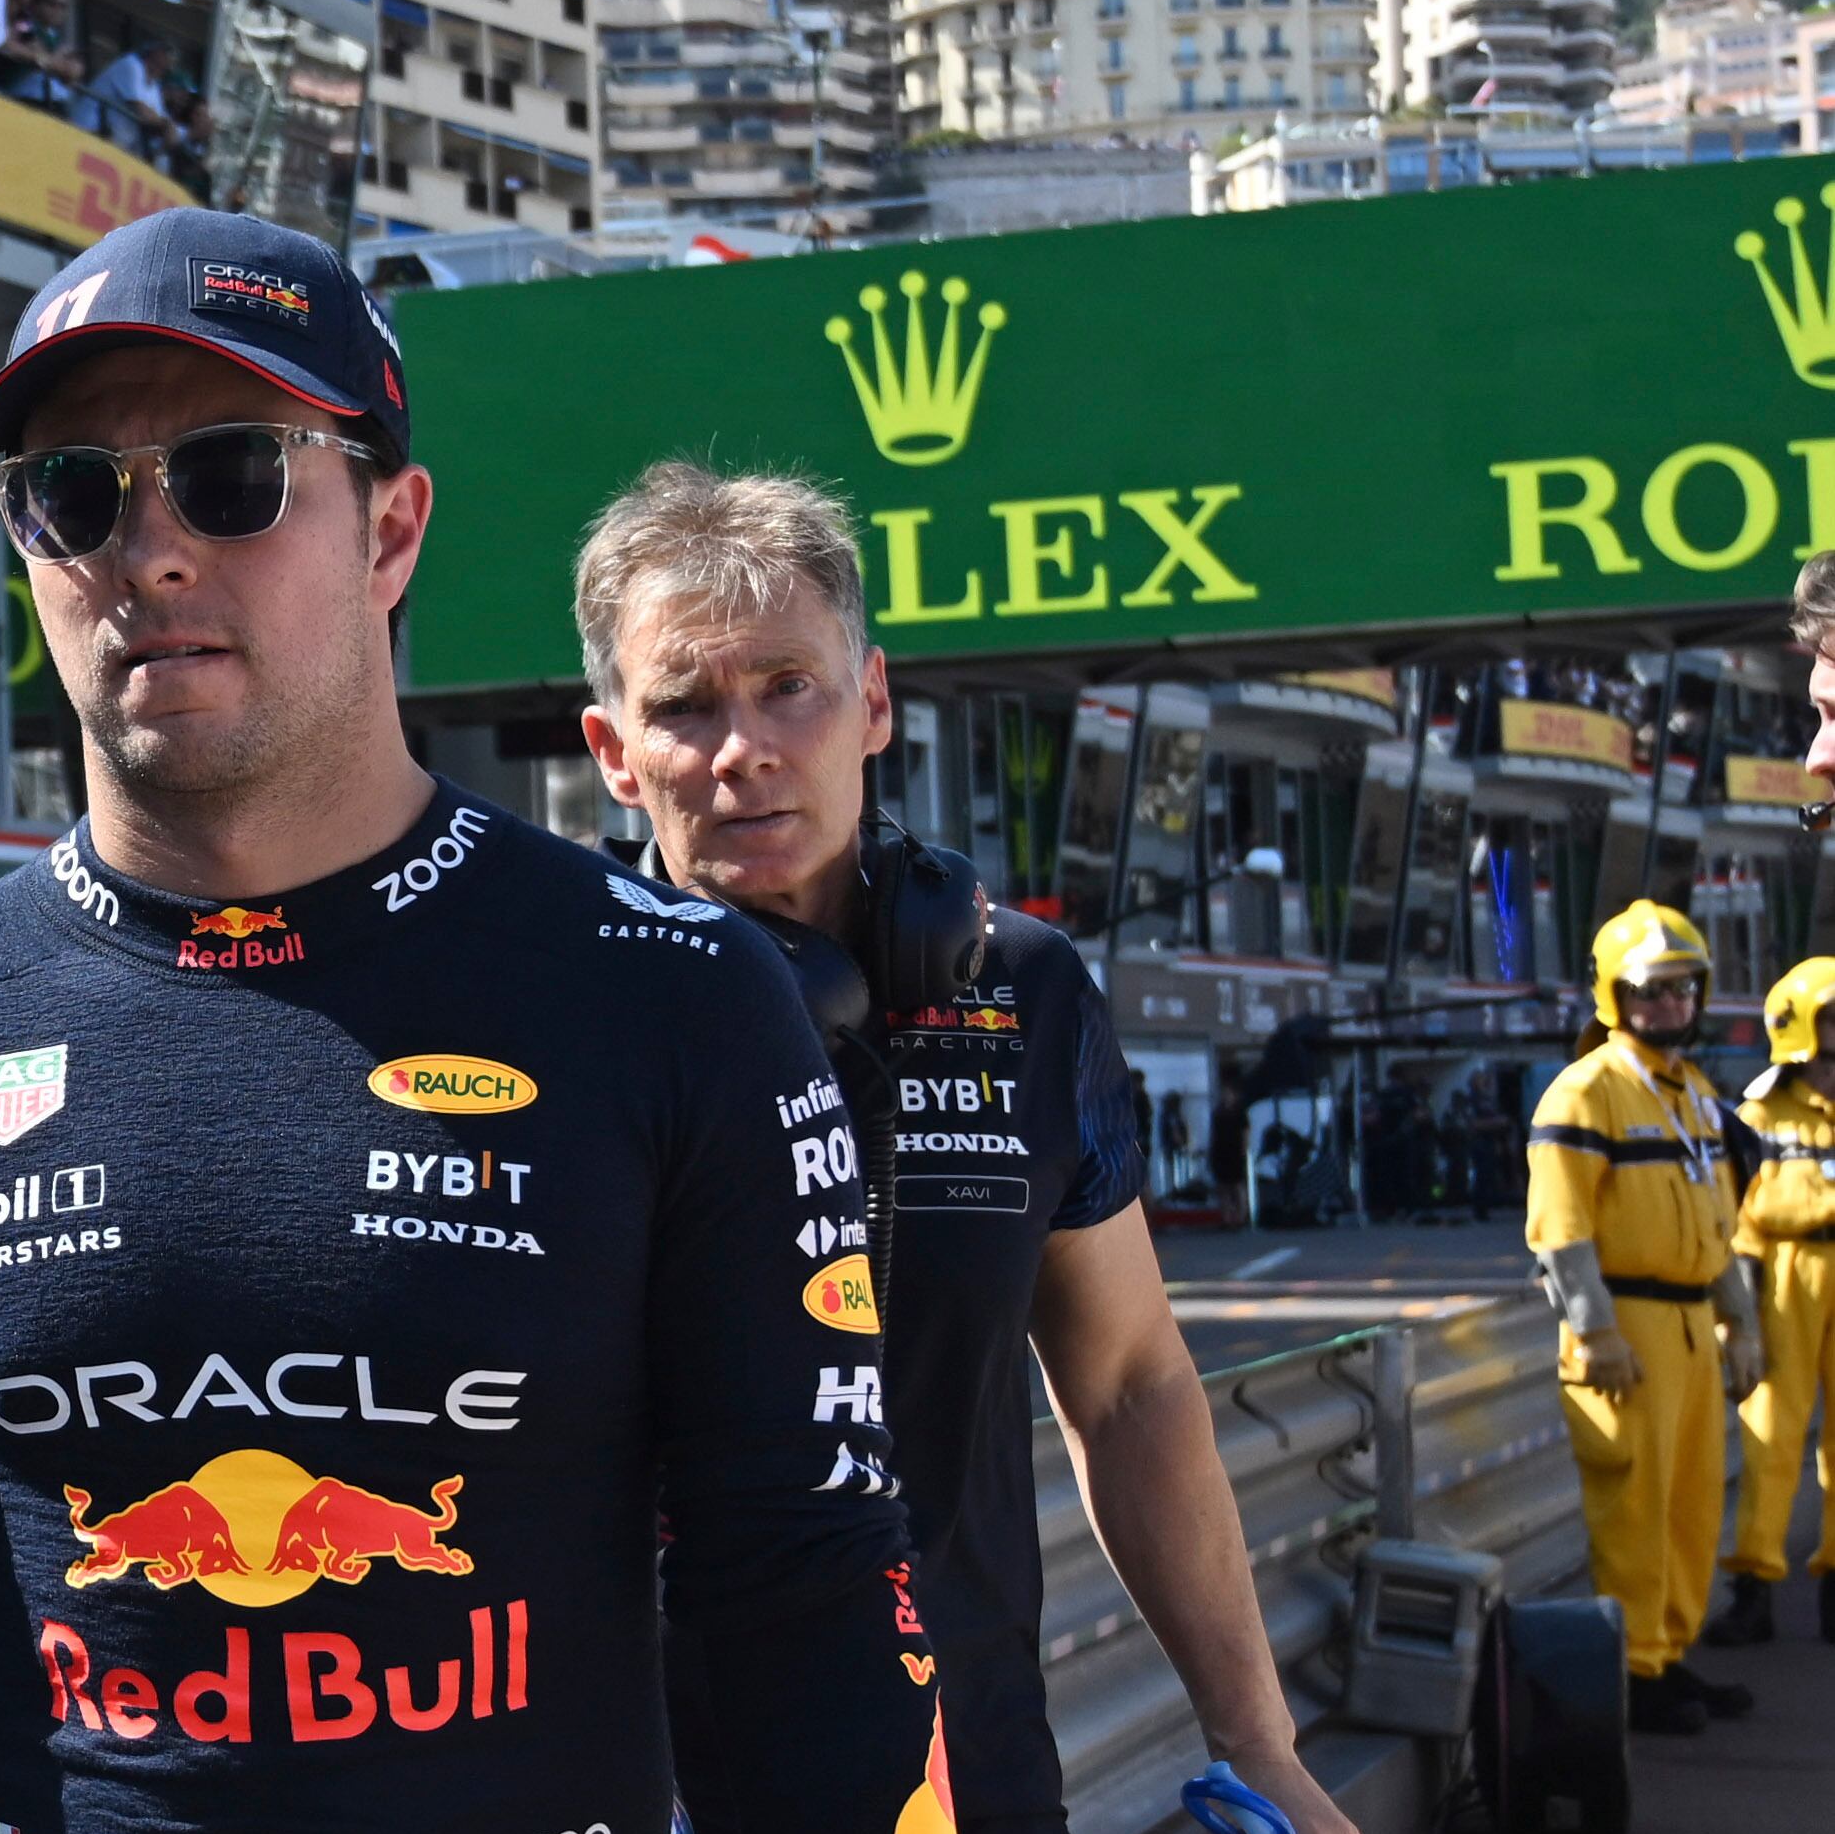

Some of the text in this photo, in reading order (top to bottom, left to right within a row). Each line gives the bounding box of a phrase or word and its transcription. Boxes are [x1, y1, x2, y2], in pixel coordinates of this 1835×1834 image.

[203, 264, 307, 297] ORACLE
[205, 276, 264, 296] Red Bull
[37, 270, 111, 343] 11
[205, 292, 308, 326] RACING
[857, 483, 1259, 625] LEX
[371, 805, 490, 913] zoom
[50, 829, 120, 926] zoom
[176, 932, 306, 969] Red Bull
[598, 924, 720, 957] CASTORE
[889, 1036, 1025, 1052] RACING
[414, 1070, 516, 1100] RAUCH
[898, 1070, 1017, 1114] BYBIT
[894, 1133, 1030, 1156] HONDA
[68, 1170, 85, 1206] 1
[366, 1149, 532, 1204] BYBIT
[945, 1185, 991, 1201] XAVI
[350, 1213, 546, 1256] HONDA
[39, 1599, 529, 1744] Red Bull
